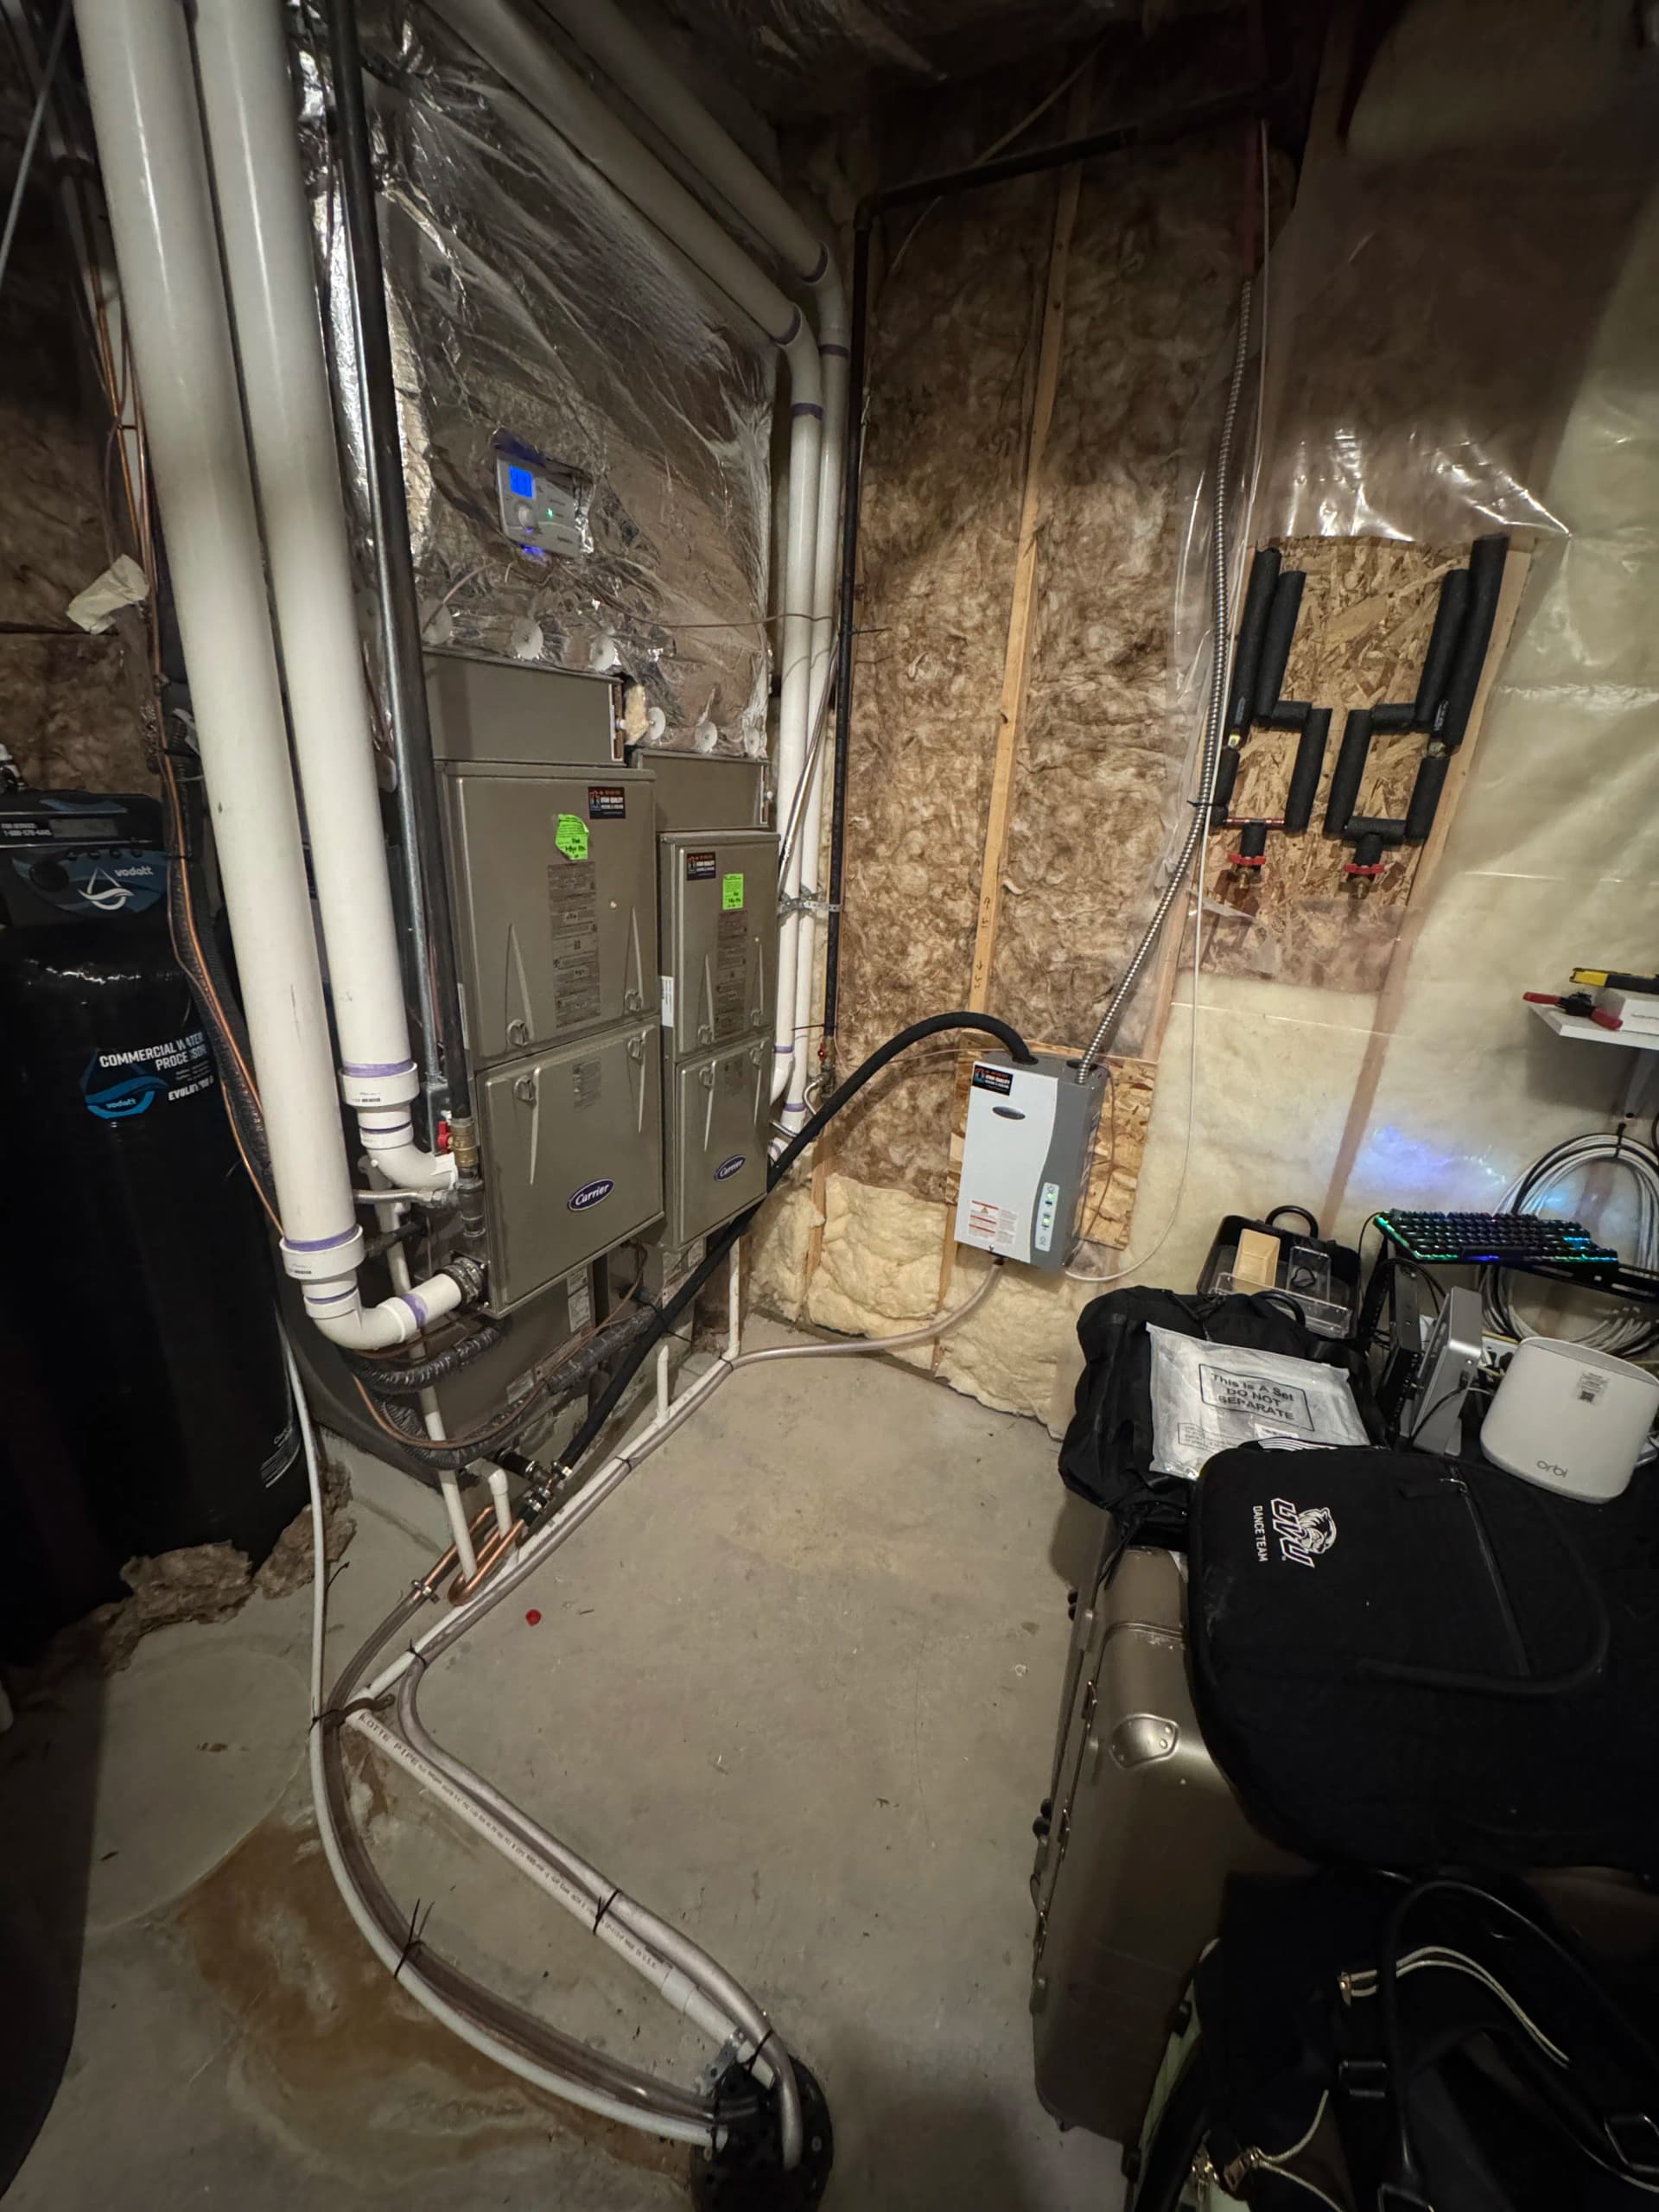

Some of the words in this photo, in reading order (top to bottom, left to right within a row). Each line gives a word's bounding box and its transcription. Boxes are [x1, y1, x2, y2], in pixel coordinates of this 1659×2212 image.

[99, 1042, 177, 1068] COMMERCIAL
[156, 1045, 207, 1071] PROCESOR
[720, 1160, 743, 1177] Carrier
[575, 1184, 609, 1205] Carrier
[1211, 1373, 1239, 1388] This
[1273, 1387, 1294, 1402] Set
[1227, 1388, 1248, 1397] DO
[1252, 1392, 1281, 1407] NOT
[1218, 1395, 1294, 1420] SEPARATE
[1536, 1460, 1568, 1478] orbi
[1253, 1505, 1265, 1535] DANCE
[1271, 1497, 1315, 1568] UVU
[1255, 1535, 1268, 1562] TEAM
